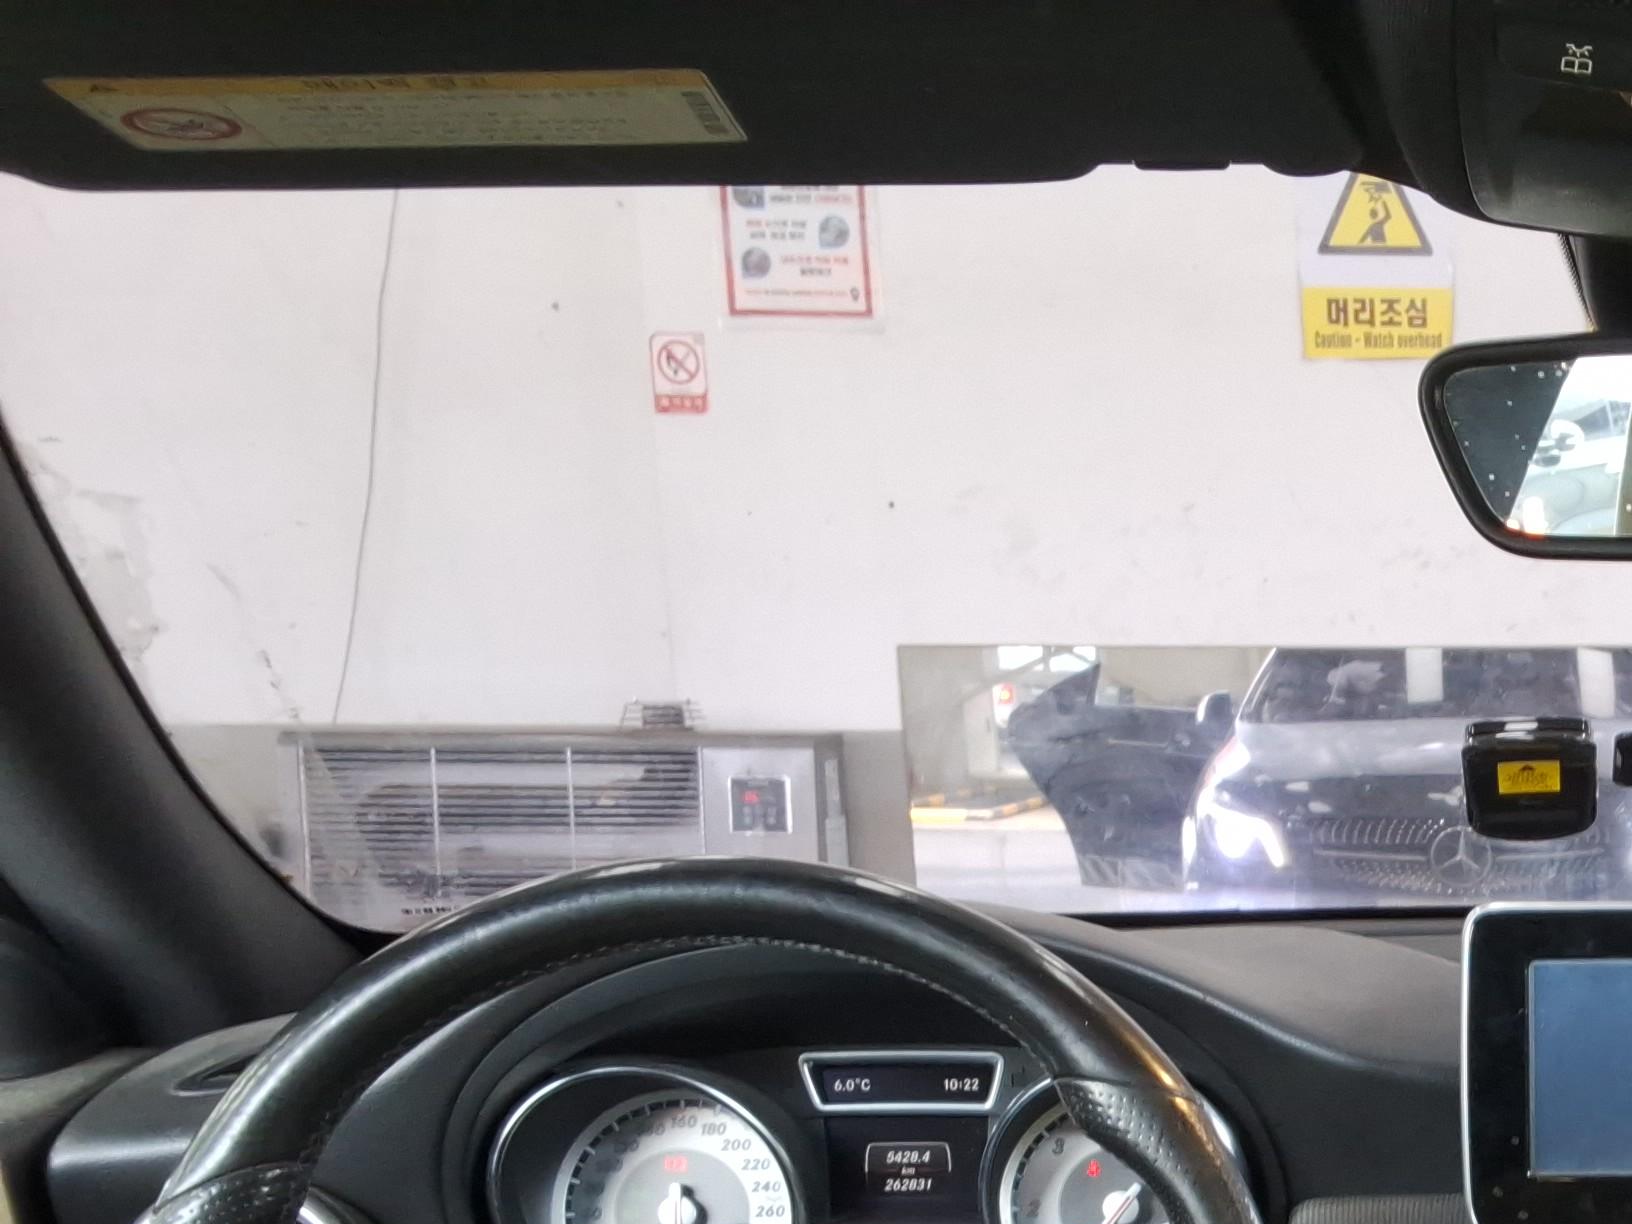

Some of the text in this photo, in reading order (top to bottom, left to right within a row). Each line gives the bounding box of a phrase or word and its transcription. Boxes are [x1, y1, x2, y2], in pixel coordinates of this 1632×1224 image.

[1326, 298, 1427, 328] 머리조심
[1315, 330, 1353, 349] Caution
[1363, 330, 1394, 349] Watch
[1397, 331, 1442, 349] overhead
[943, 1078, 980, 1092] 10:22
[670, 1115, 698, 1129] 160
[700, 1121, 727, 1136] 180
[721, 1138, 752, 1152] 200
[741, 1158, 771, 1171] 220
[751, 1180, 782, 1194] 240
[755, 1205, 786, 1218] 260
